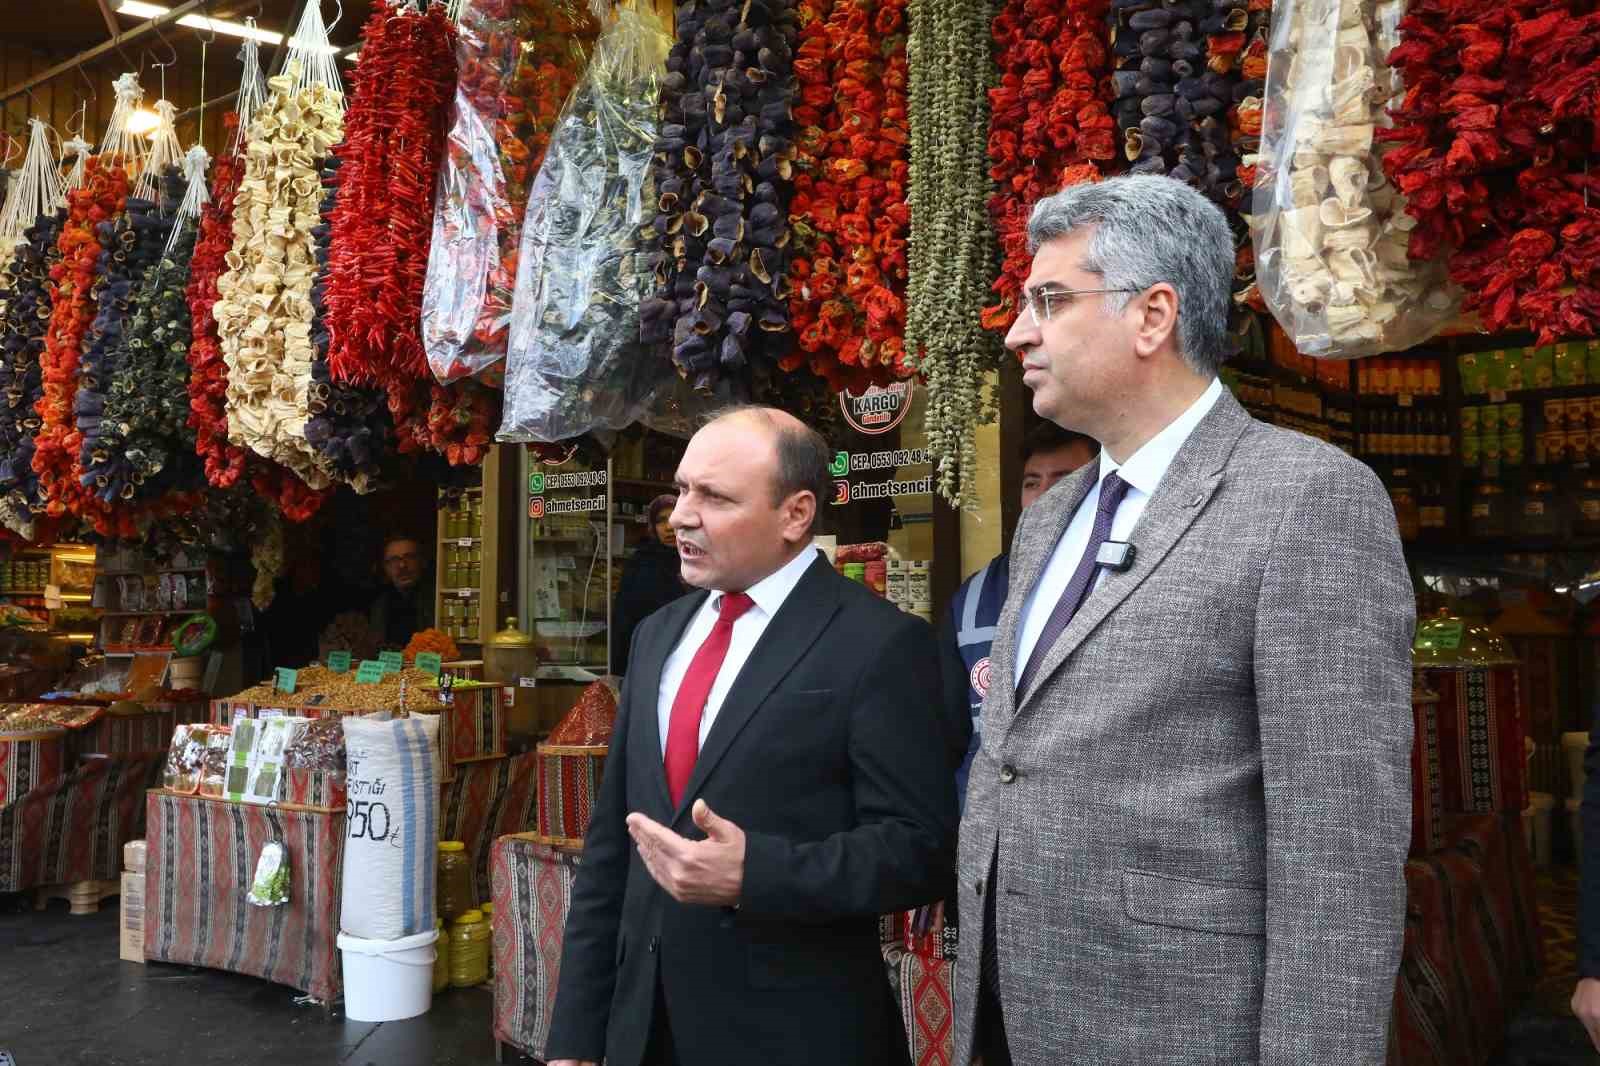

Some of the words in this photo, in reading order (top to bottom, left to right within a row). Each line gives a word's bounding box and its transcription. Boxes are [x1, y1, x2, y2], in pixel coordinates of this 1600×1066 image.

[854, 393, 899, 415] KARGO
[871, 451, 892, 468] 0553
[893, 449, 909, 466] 092
[911, 447, 922, 464] 48
